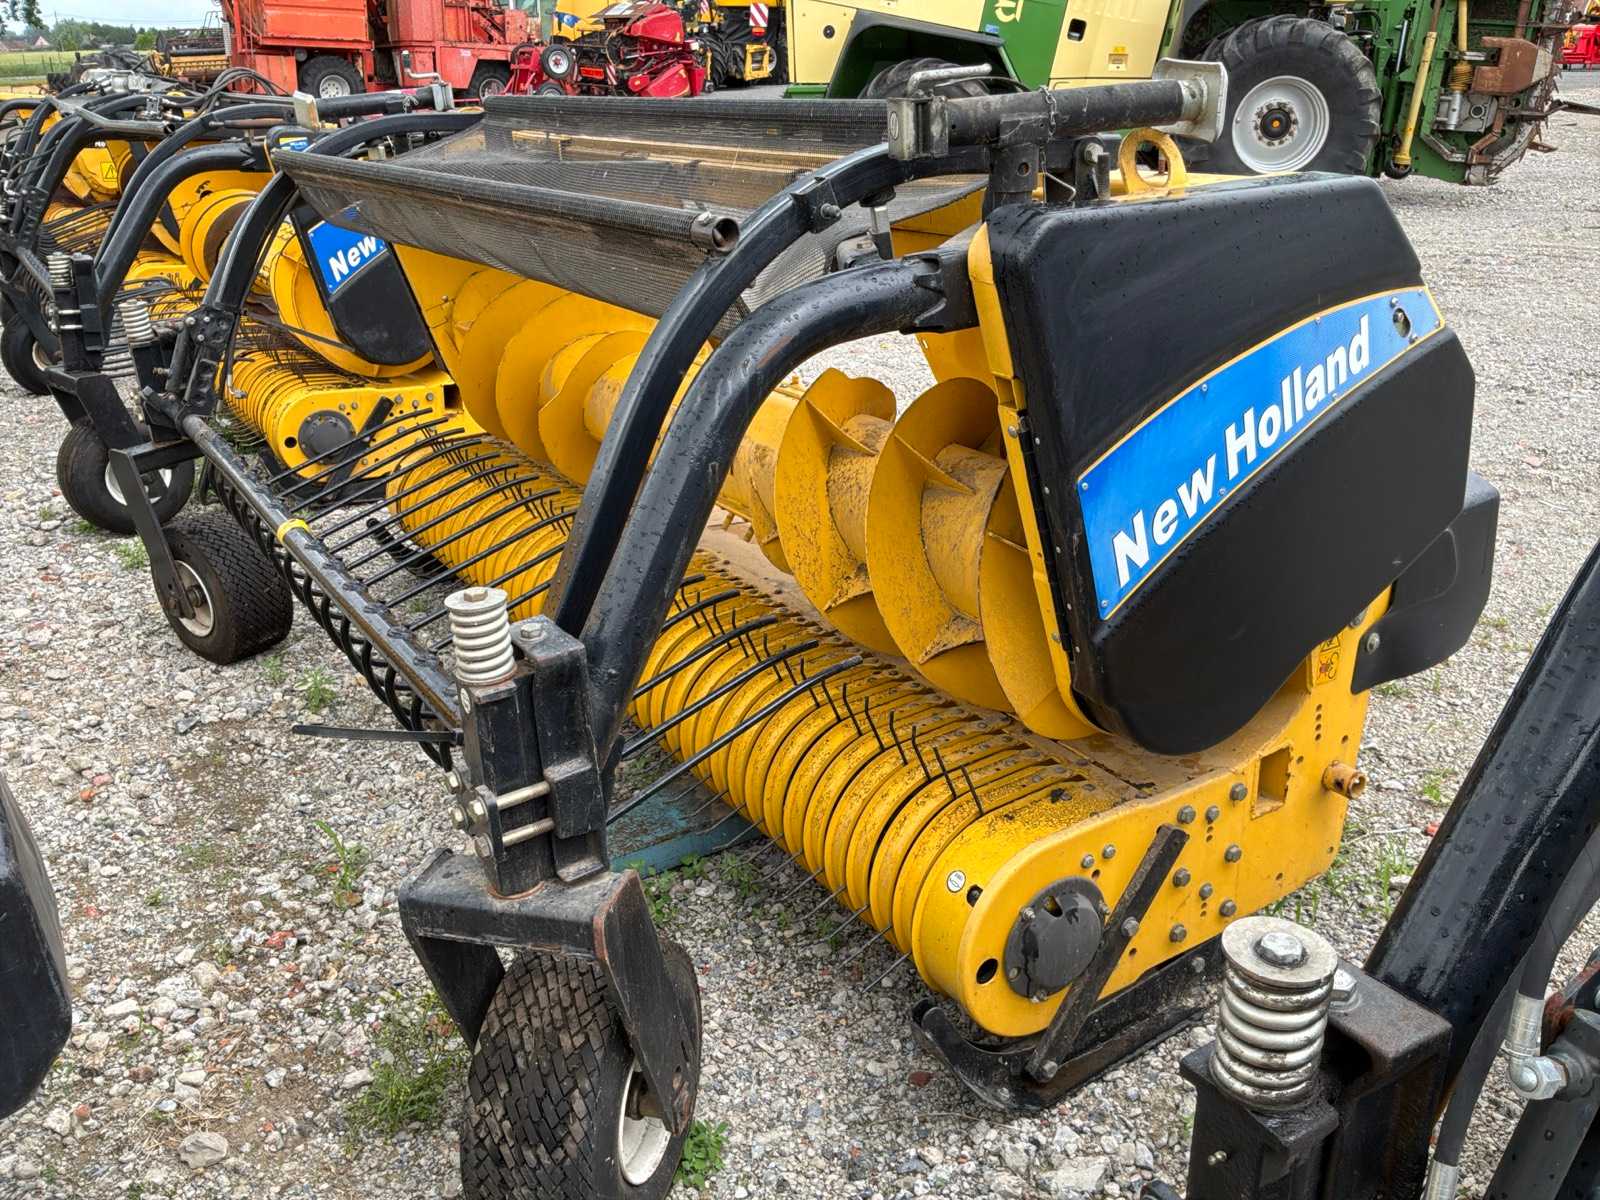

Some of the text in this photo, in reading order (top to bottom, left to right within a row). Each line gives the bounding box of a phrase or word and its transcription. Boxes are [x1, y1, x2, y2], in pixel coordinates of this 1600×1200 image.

[329, 236, 377, 282] New
[1112, 313, 1371, 588] New Holland
